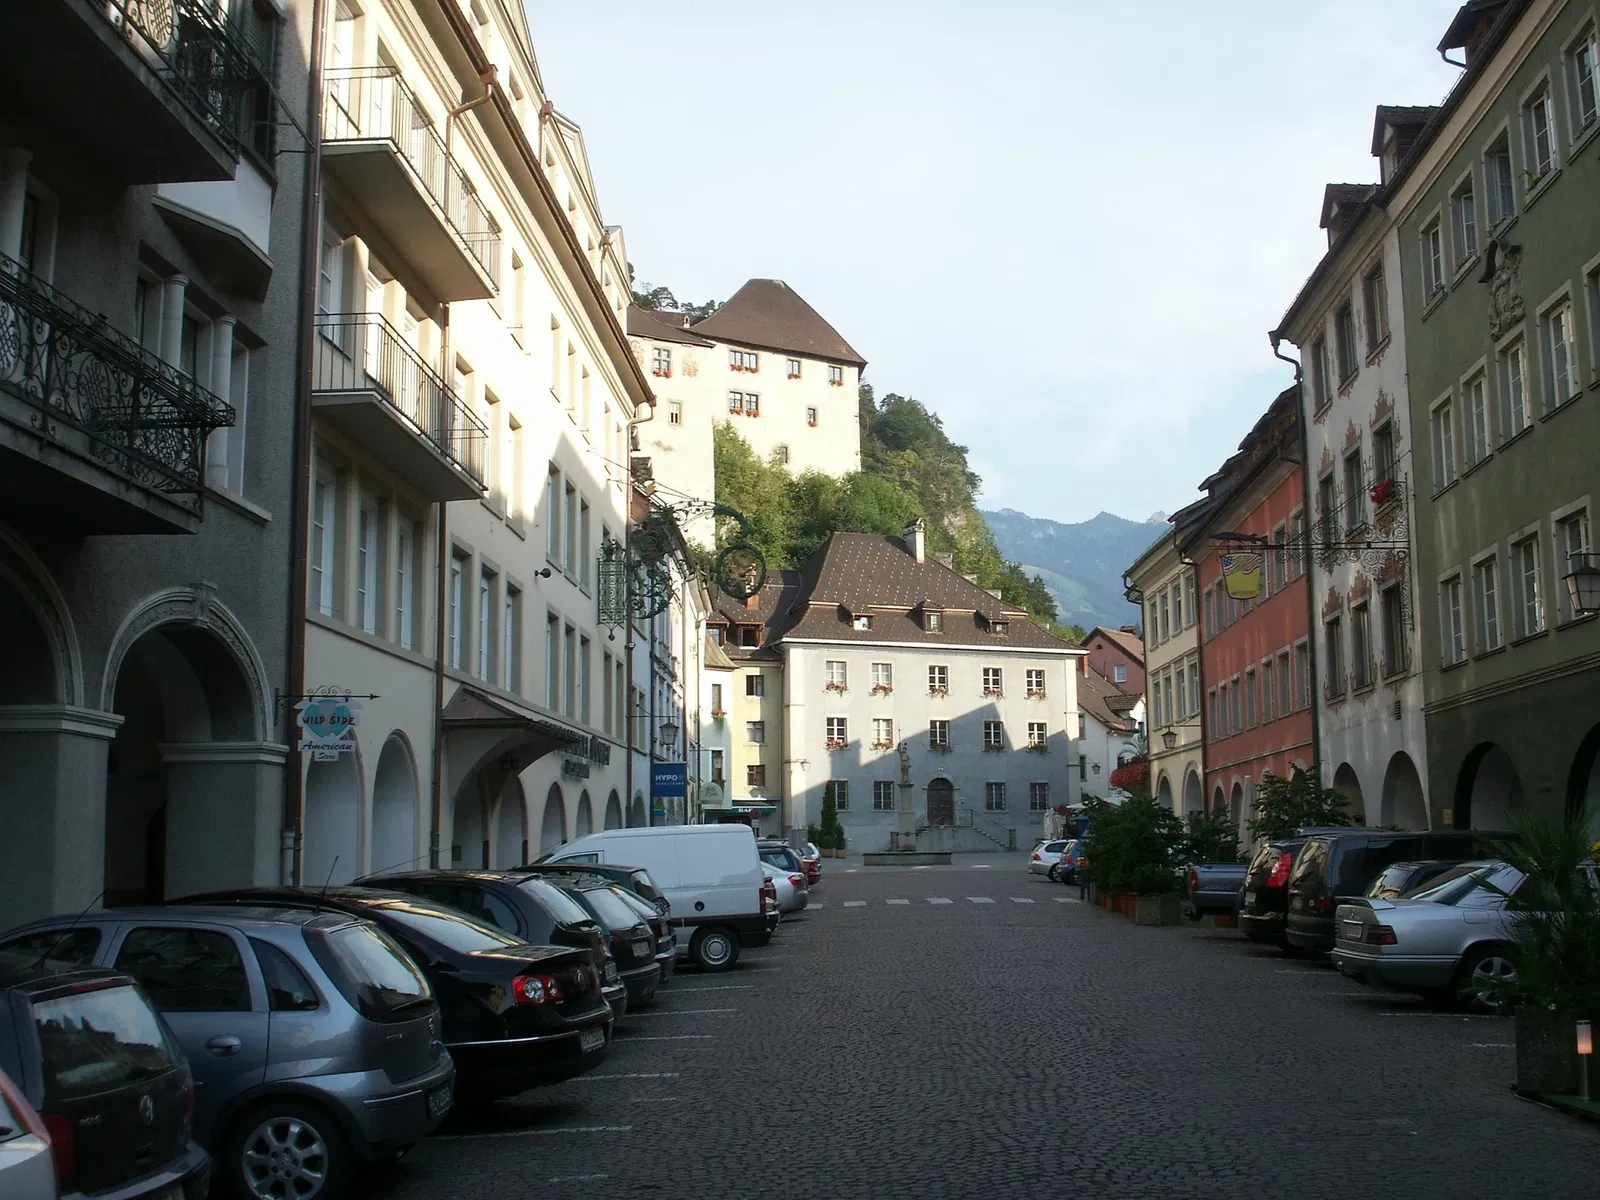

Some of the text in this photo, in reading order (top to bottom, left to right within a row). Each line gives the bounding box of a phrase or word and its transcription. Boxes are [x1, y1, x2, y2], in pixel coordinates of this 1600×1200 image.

[302, 715, 355, 725] WILD SIDE
[301, 740, 353, 750] American
[318, 752, 336, 760] Store
